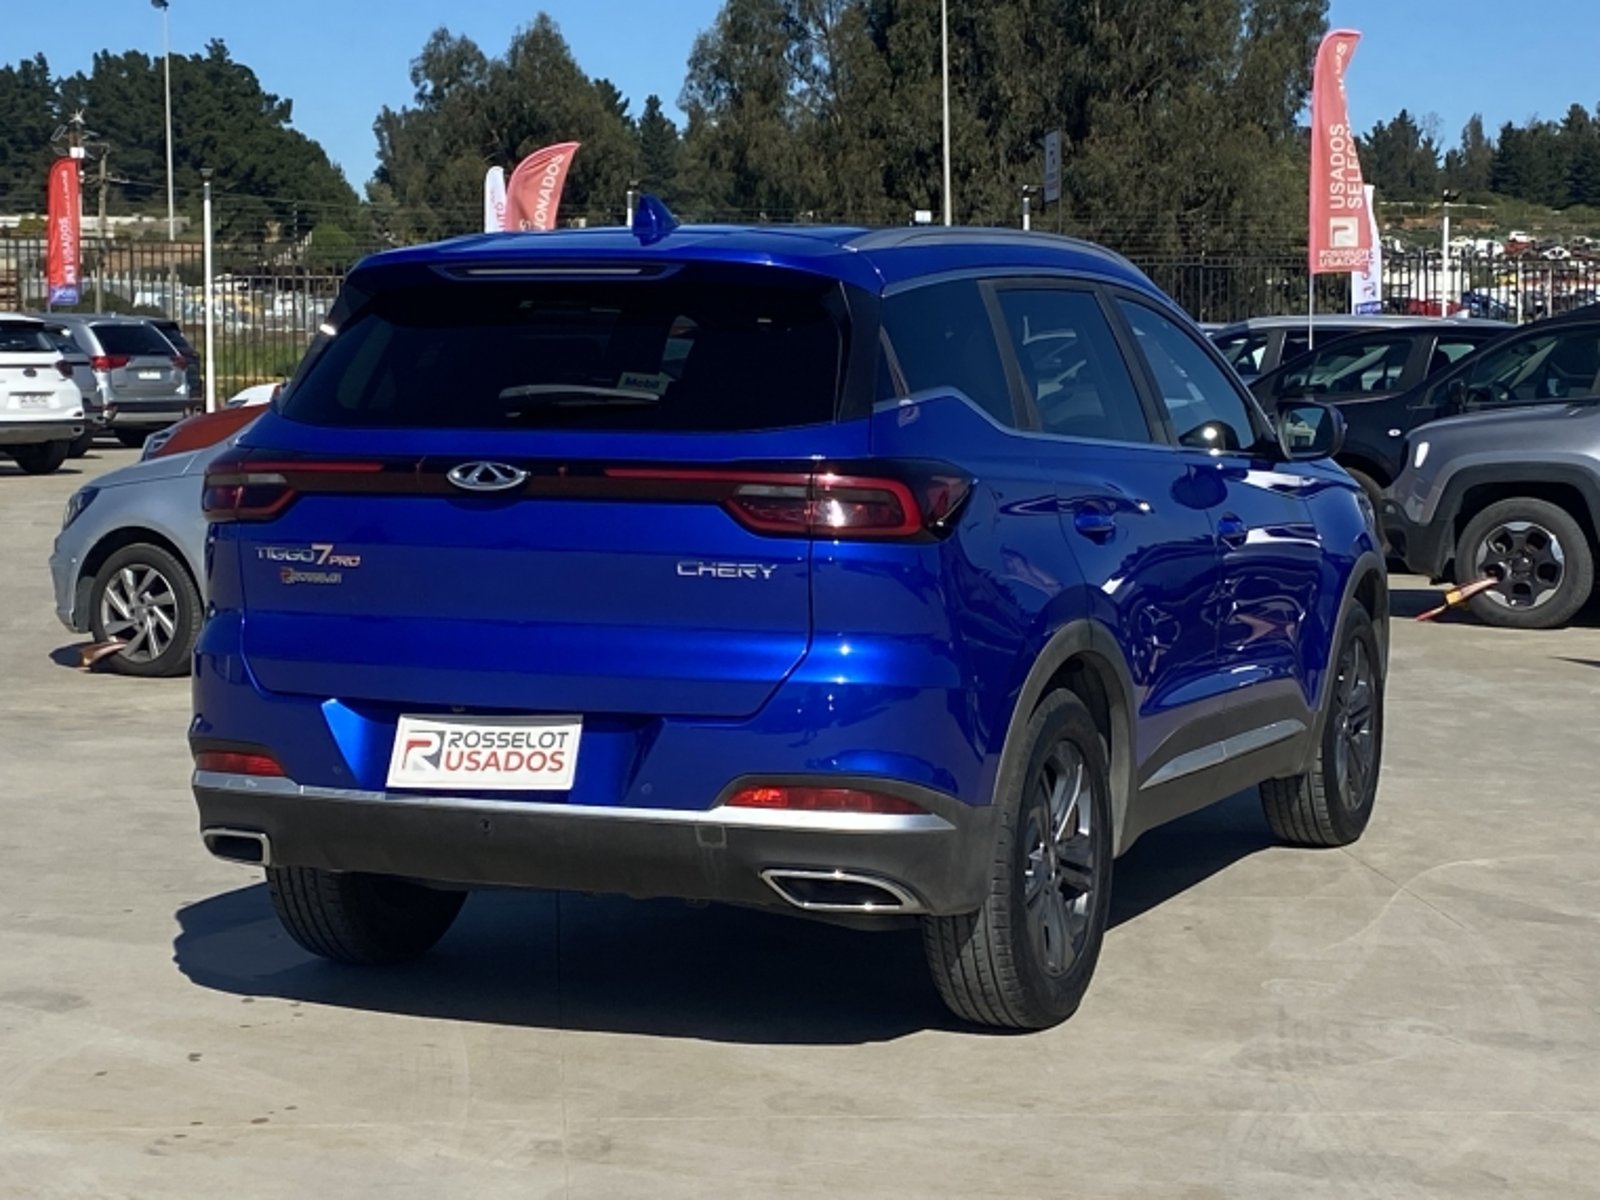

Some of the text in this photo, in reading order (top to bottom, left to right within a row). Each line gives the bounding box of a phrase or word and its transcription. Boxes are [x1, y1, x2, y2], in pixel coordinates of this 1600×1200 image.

[1329, 123, 1346, 209] USADOS
[255, 543, 361, 568] TIGGO 7 PRO
[677, 561, 778, 579] CHERY
[447, 730, 570, 749] ROSSELOT
[445, 750, 566, 772] USADOS
